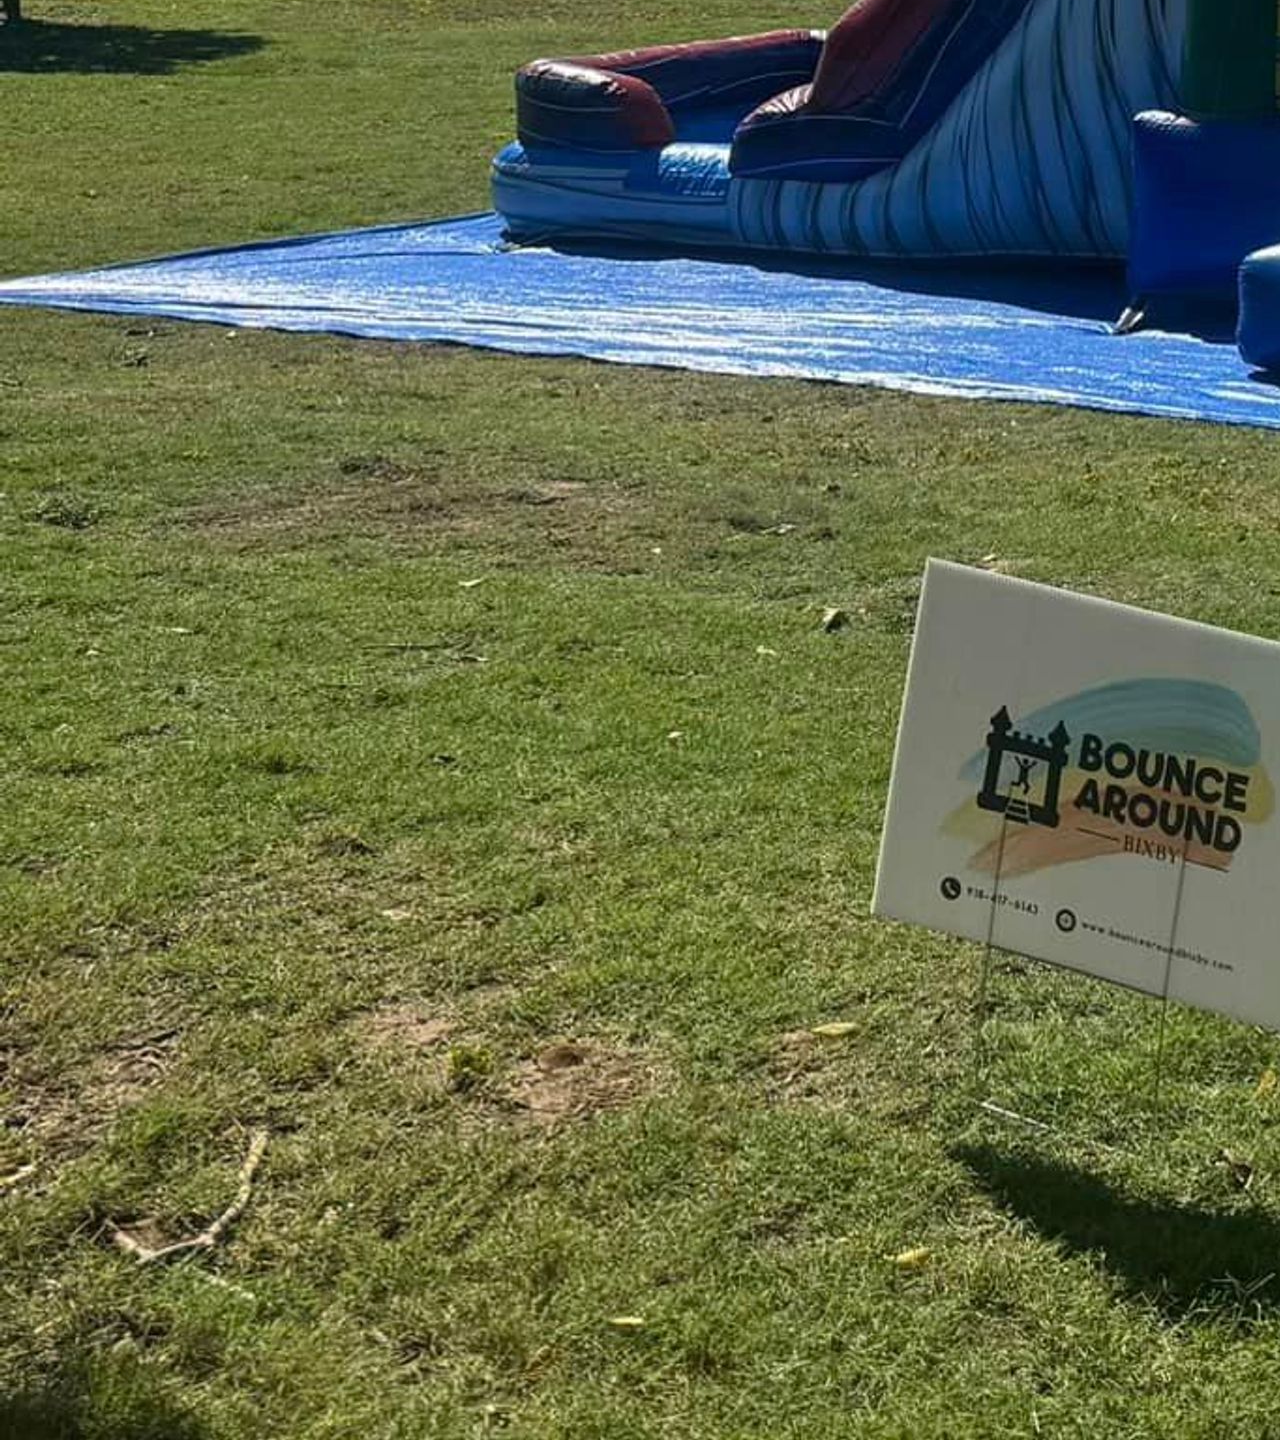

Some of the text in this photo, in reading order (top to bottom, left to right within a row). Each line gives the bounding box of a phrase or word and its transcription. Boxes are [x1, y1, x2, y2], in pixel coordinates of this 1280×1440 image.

[1078, 733, 1250, 812] BOUNCE
[1073, 778, 1243, 853] AROUND
[1123, 835, 1181, 863] BIXBY
